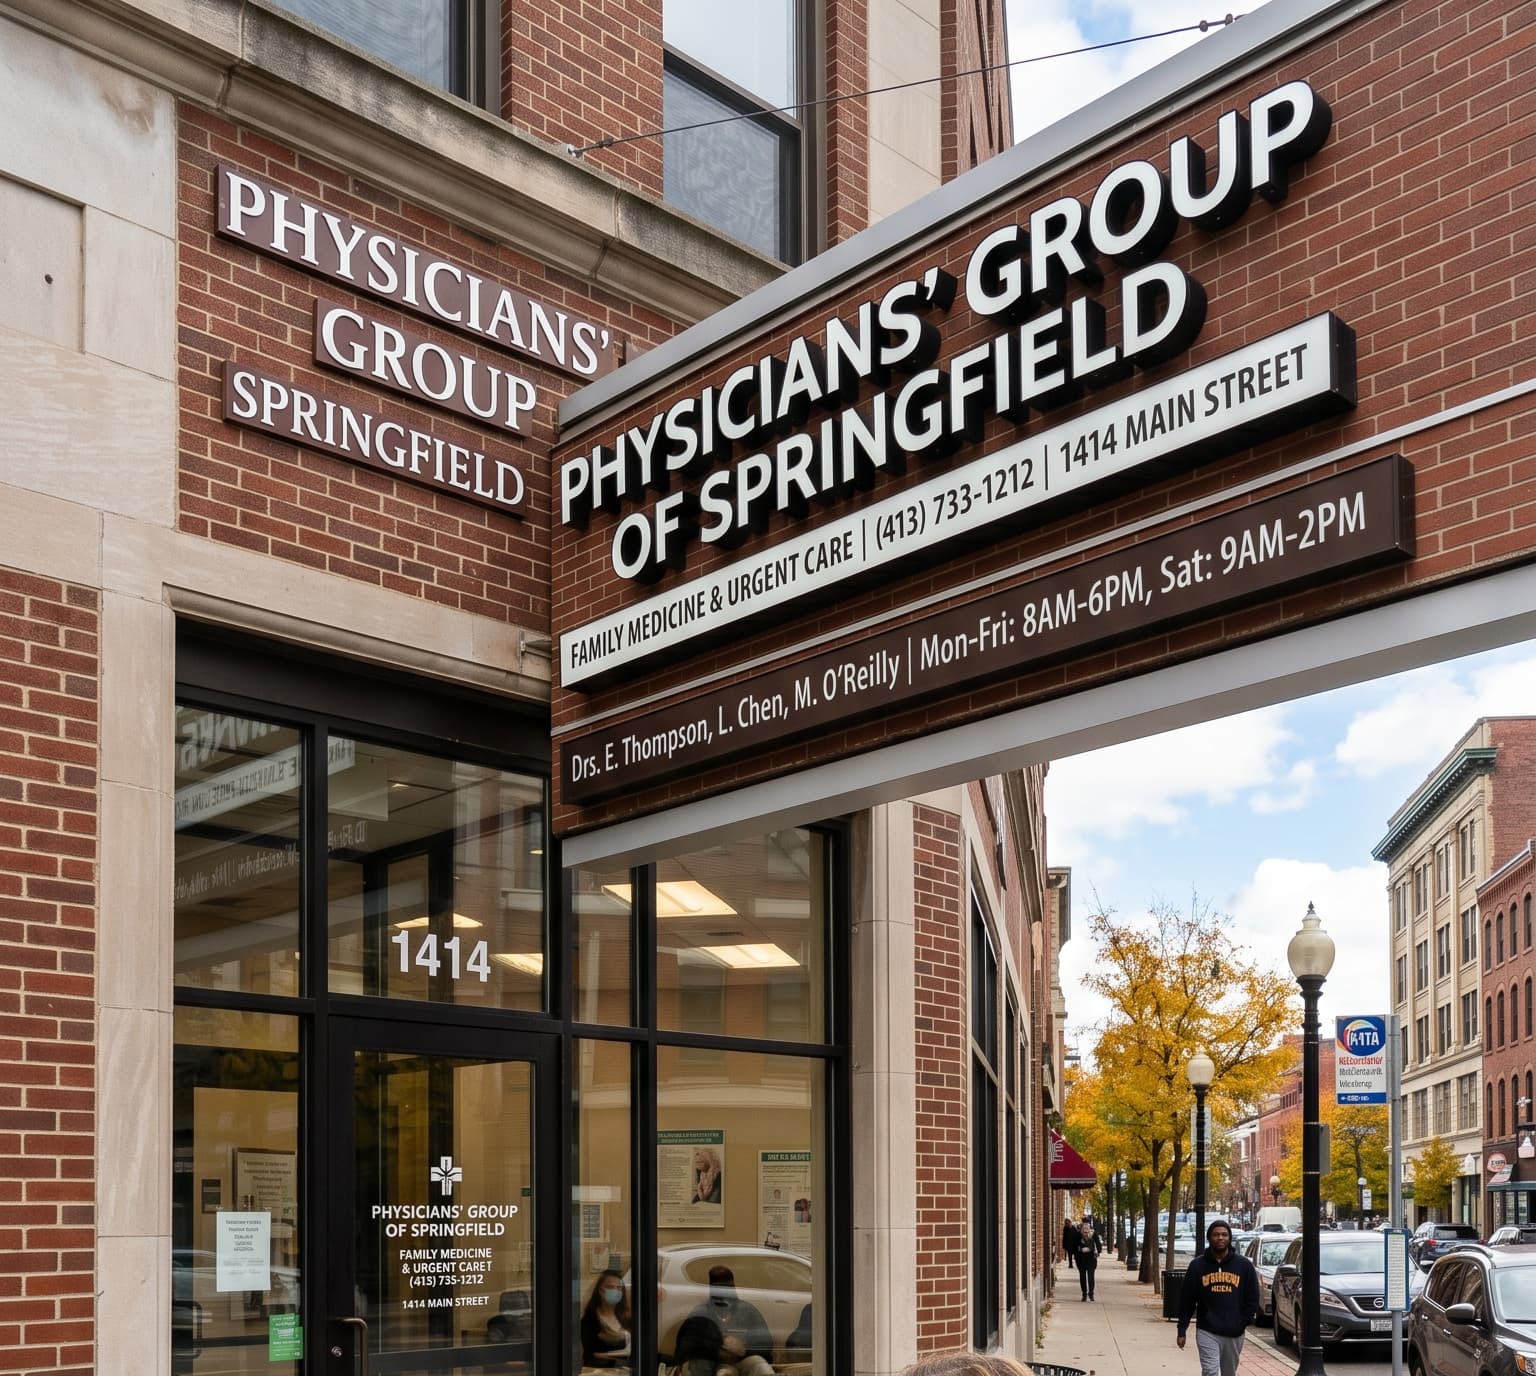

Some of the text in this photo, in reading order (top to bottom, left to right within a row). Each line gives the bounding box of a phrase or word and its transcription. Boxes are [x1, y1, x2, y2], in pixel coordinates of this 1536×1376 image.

[965, 80, 1314, 316] GROUP
[321, 308, 537, 431] GROUP
[232, 370, 525, 506] SPRINGFIELD
[611, 261, 1188, 581] OF SPRINGFIELD
[571, 344, 1307, 668] FAMILY MEDICINE & URGENT CARE (413) 733-1212 1414 MAIN STREET
[572, 754, 600, 782] Drs.
[604, 743, 618, 771] E.
[622, 717, 713, 765] Thompson,
[718, 705, 733, 735] L.
[738, 693, 788, 729] Chen,
[794, 679, 817, 711] M.
[921, 613, 1015, 671] Mon-Fri:
[1022, 566, 1153, 637] 8AM-6PM,
[1160, 549, 1213, 595] Sat:
[1221, 491, 1366, 574] 9AM-2PM
[392, 929, 491, 983] 1414
[385, 1222, 505, 1238] OF SPRINGFIELD
[400, 1247, 493, 1260] FAMILY MEDICINE
[467, 1205, 519, 1219] GROUP
[402, 1263, 410, 1274] &
[413, 1262, 457, 1274] URGENT
[402, 1296, 489, 1310] 1414 MAIN STREET
